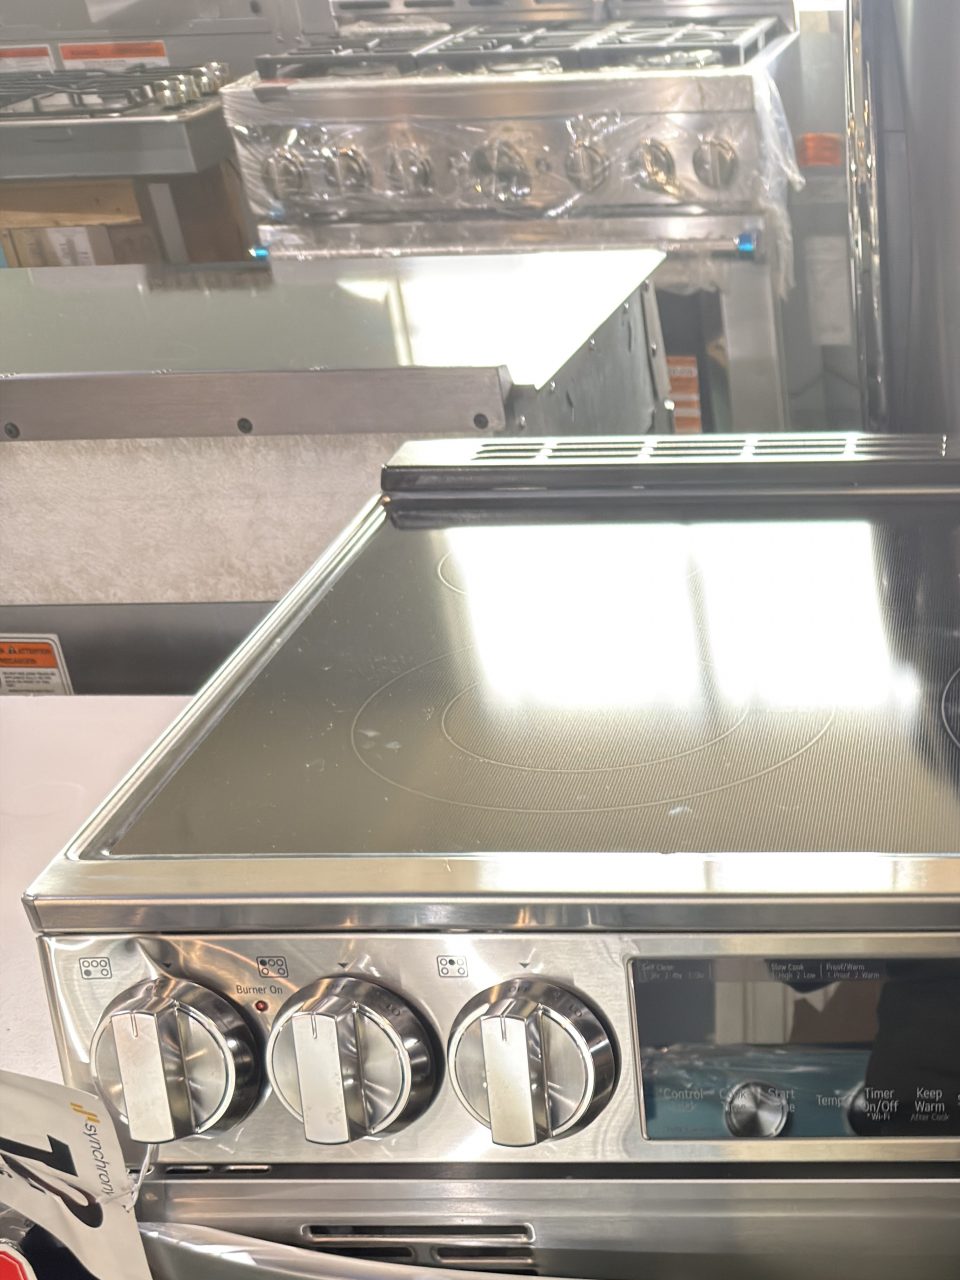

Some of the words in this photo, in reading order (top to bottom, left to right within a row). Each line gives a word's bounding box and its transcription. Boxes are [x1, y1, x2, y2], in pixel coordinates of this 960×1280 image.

[236, 984, 267, 995] Burner
[269, 984, 283, 995] On
[864, 1087, 895, 1099] Timer
[916, 1087, 943, 1101] Keep
[863, 1100, 900, 1113] On/Off
[915, 1100, 945, 1113] Warm
